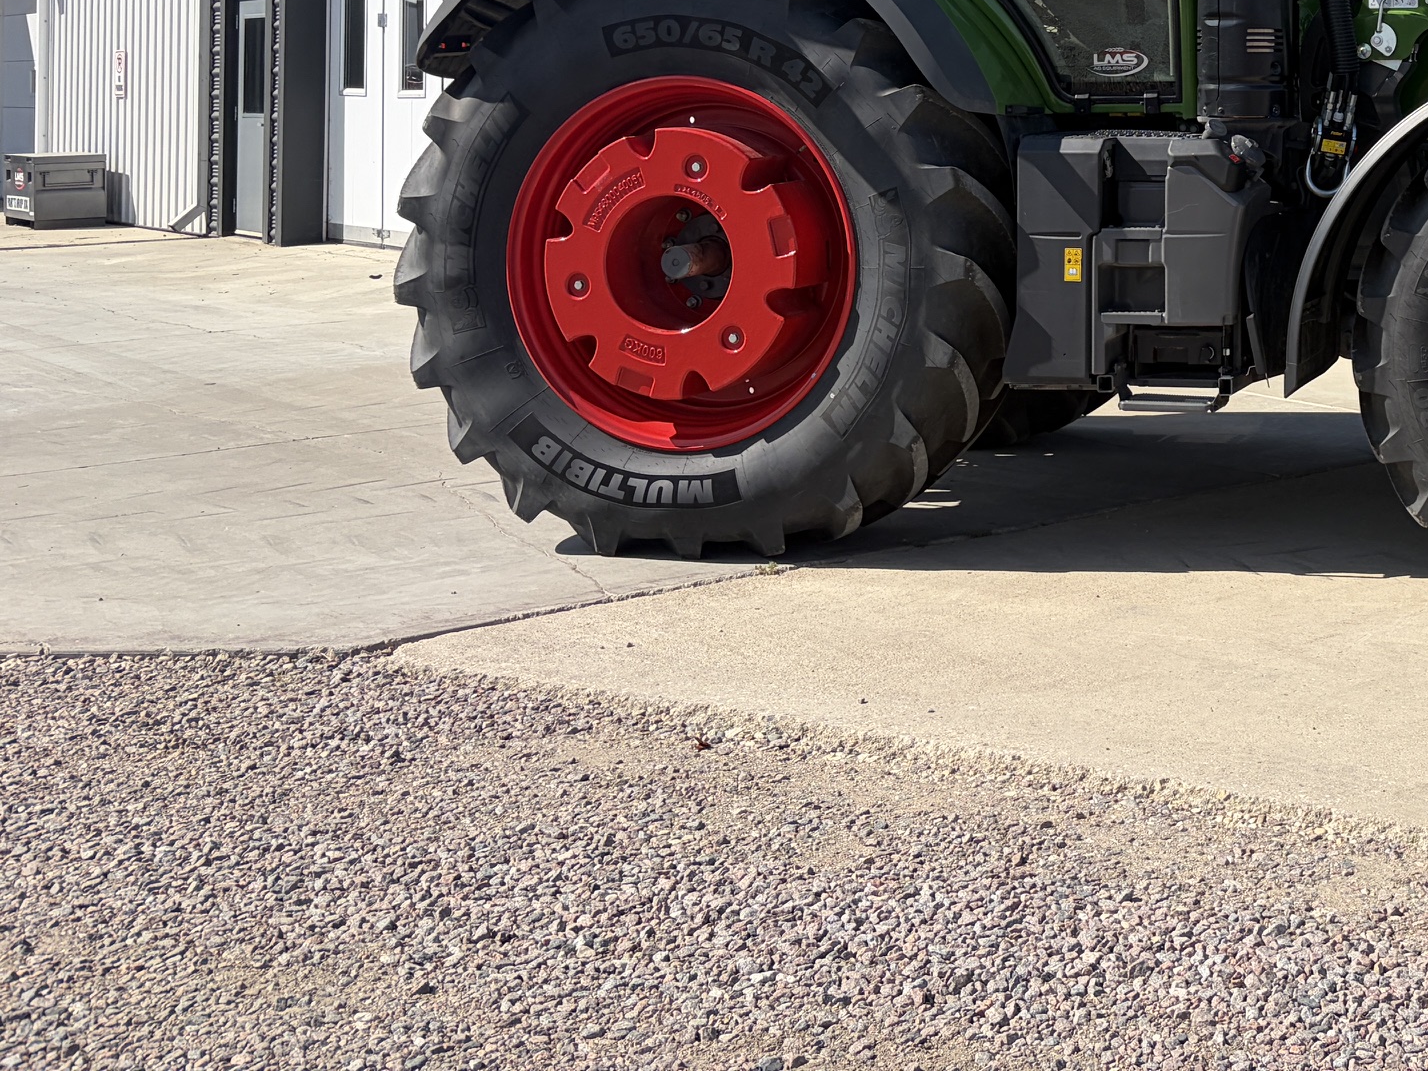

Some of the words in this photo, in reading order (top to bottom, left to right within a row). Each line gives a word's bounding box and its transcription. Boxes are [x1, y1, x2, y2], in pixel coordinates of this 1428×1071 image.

[611, 17, 742, 52] 650/65
[748, 35, 778, 67] R
[780, 52, 831, 100] 42
[1093, 53, 1138, 65] LMS
[829, 240, 907, 436] MICHELIN
[532, 437, 715, 505] MULTIBIB
